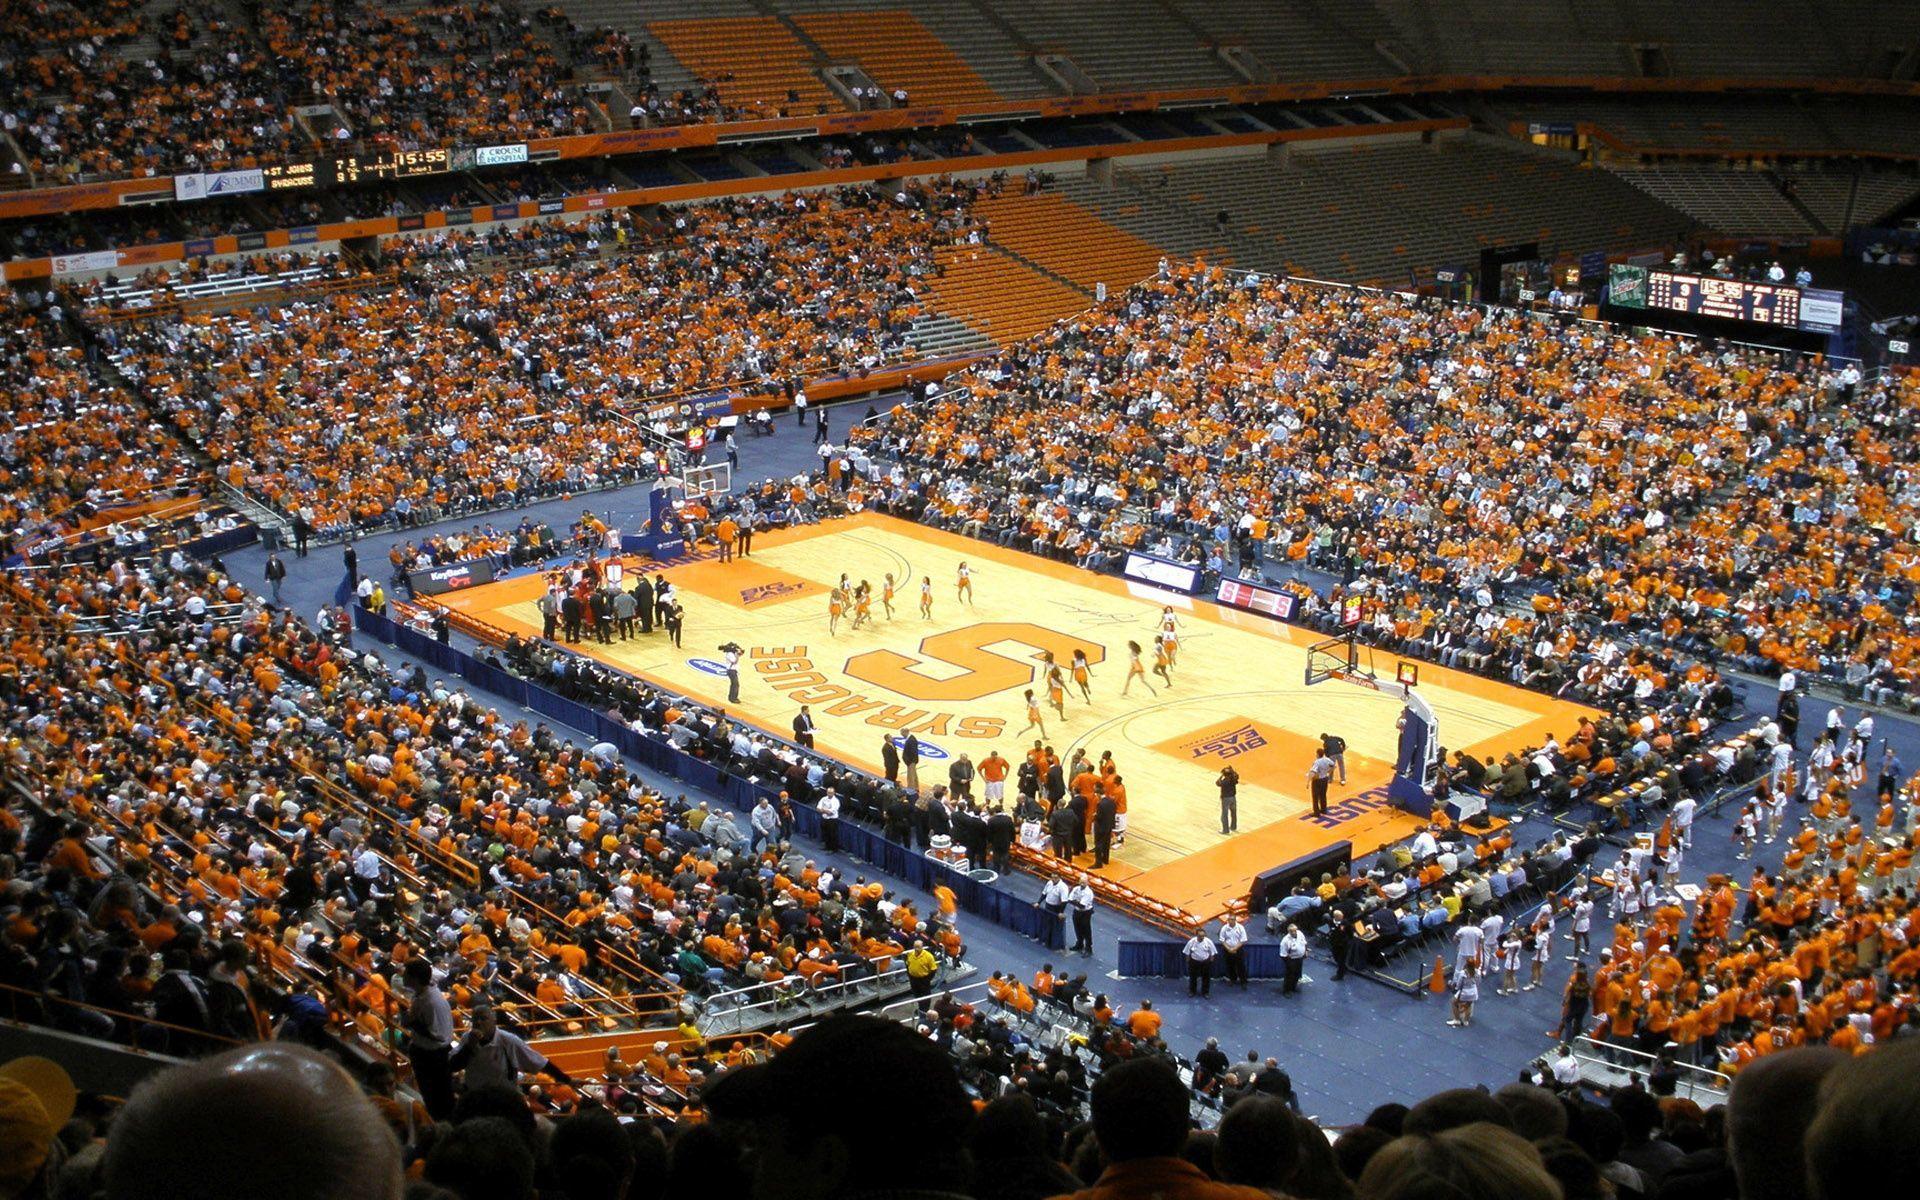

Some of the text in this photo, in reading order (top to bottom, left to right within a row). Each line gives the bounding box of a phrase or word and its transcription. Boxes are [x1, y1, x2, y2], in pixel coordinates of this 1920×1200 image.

[400, 150, 446, 165] 15:55
[487, 154, 527, 162] HOSPITAL
[489, 147, 521, 155] CROUSE
[1680, 284, 1690, 297] 9
[1703, 281, 1741, 299] 15:55
[1752, 292, 1763, 306] 7
[430, 567, 470, 581] KeyBank
[842, 622, 1106, 701] S
[749, 645, 1008, 739] SYRACUSE
[1192, 729, 1259, 759] EAST
[1218, 736, 1268, 760] BIG
